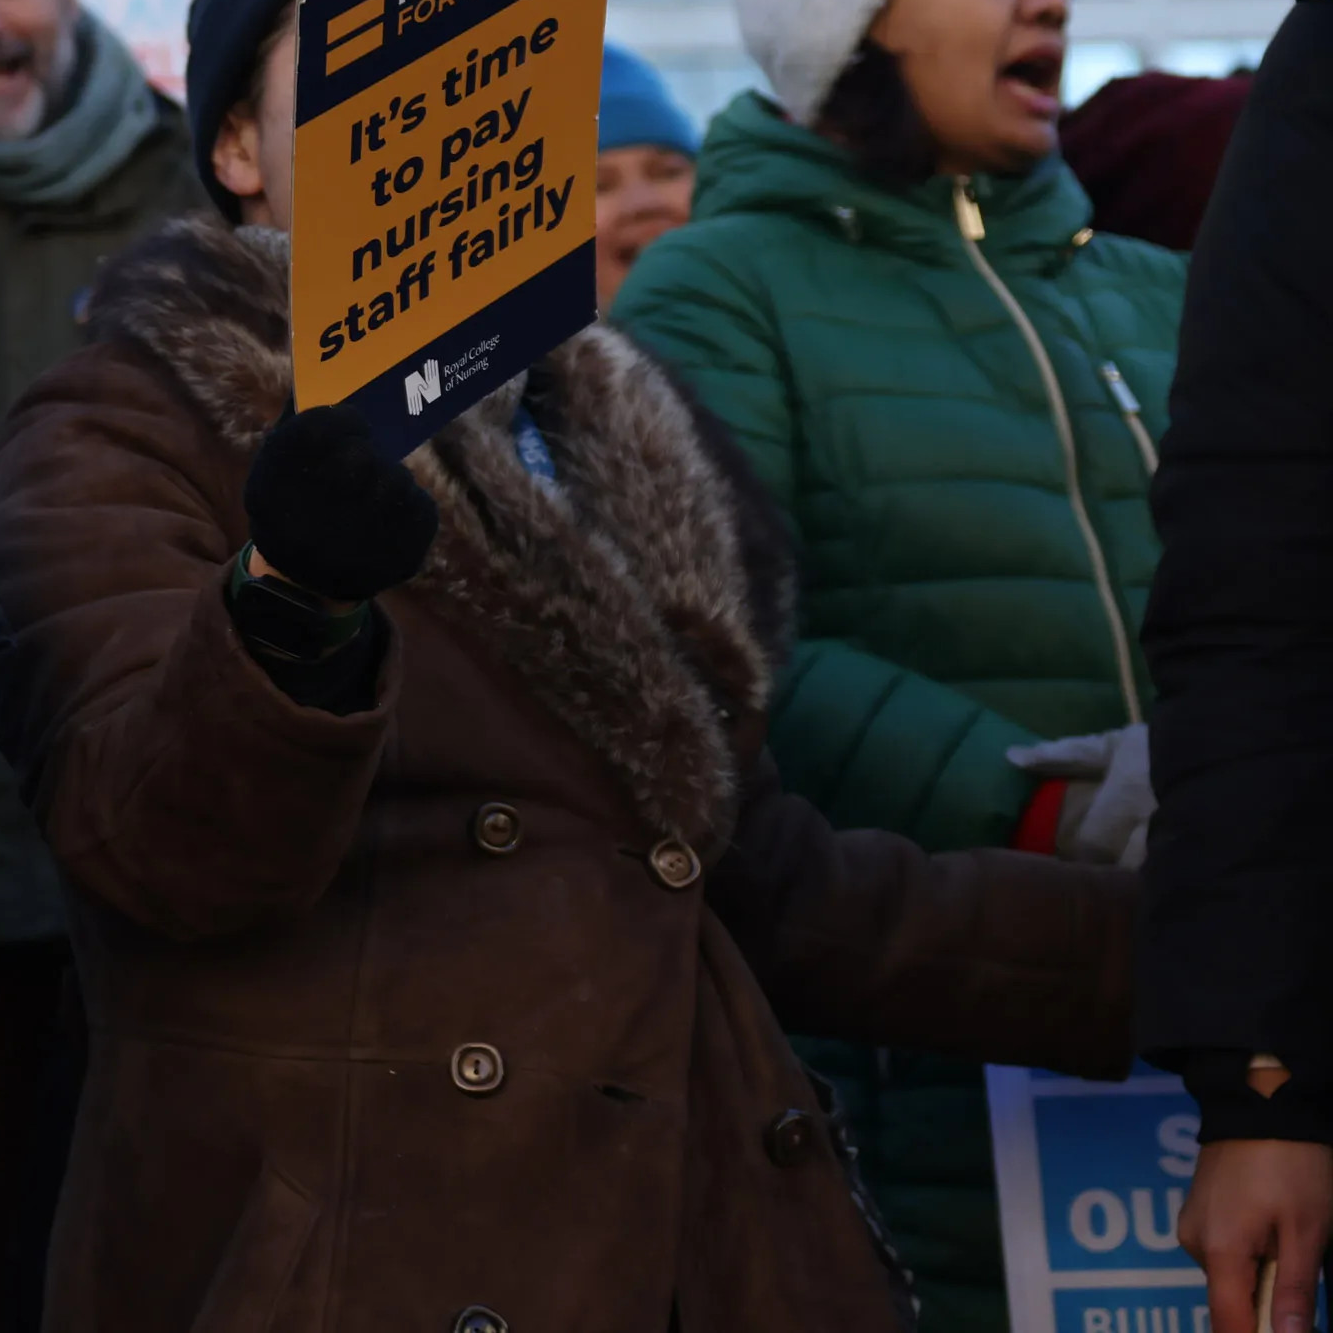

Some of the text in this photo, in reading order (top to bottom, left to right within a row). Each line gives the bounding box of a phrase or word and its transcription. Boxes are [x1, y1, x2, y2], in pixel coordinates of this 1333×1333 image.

[350, 17, 559, 166] It's time
[371, 86, 532, 207] to pay
[319, 174, 575, 363] staff fairly
[352, 136, 544, 282] nursing
[444, 334, 500, 377] Royal College
[445, 357, 489, 392] of Nursing
